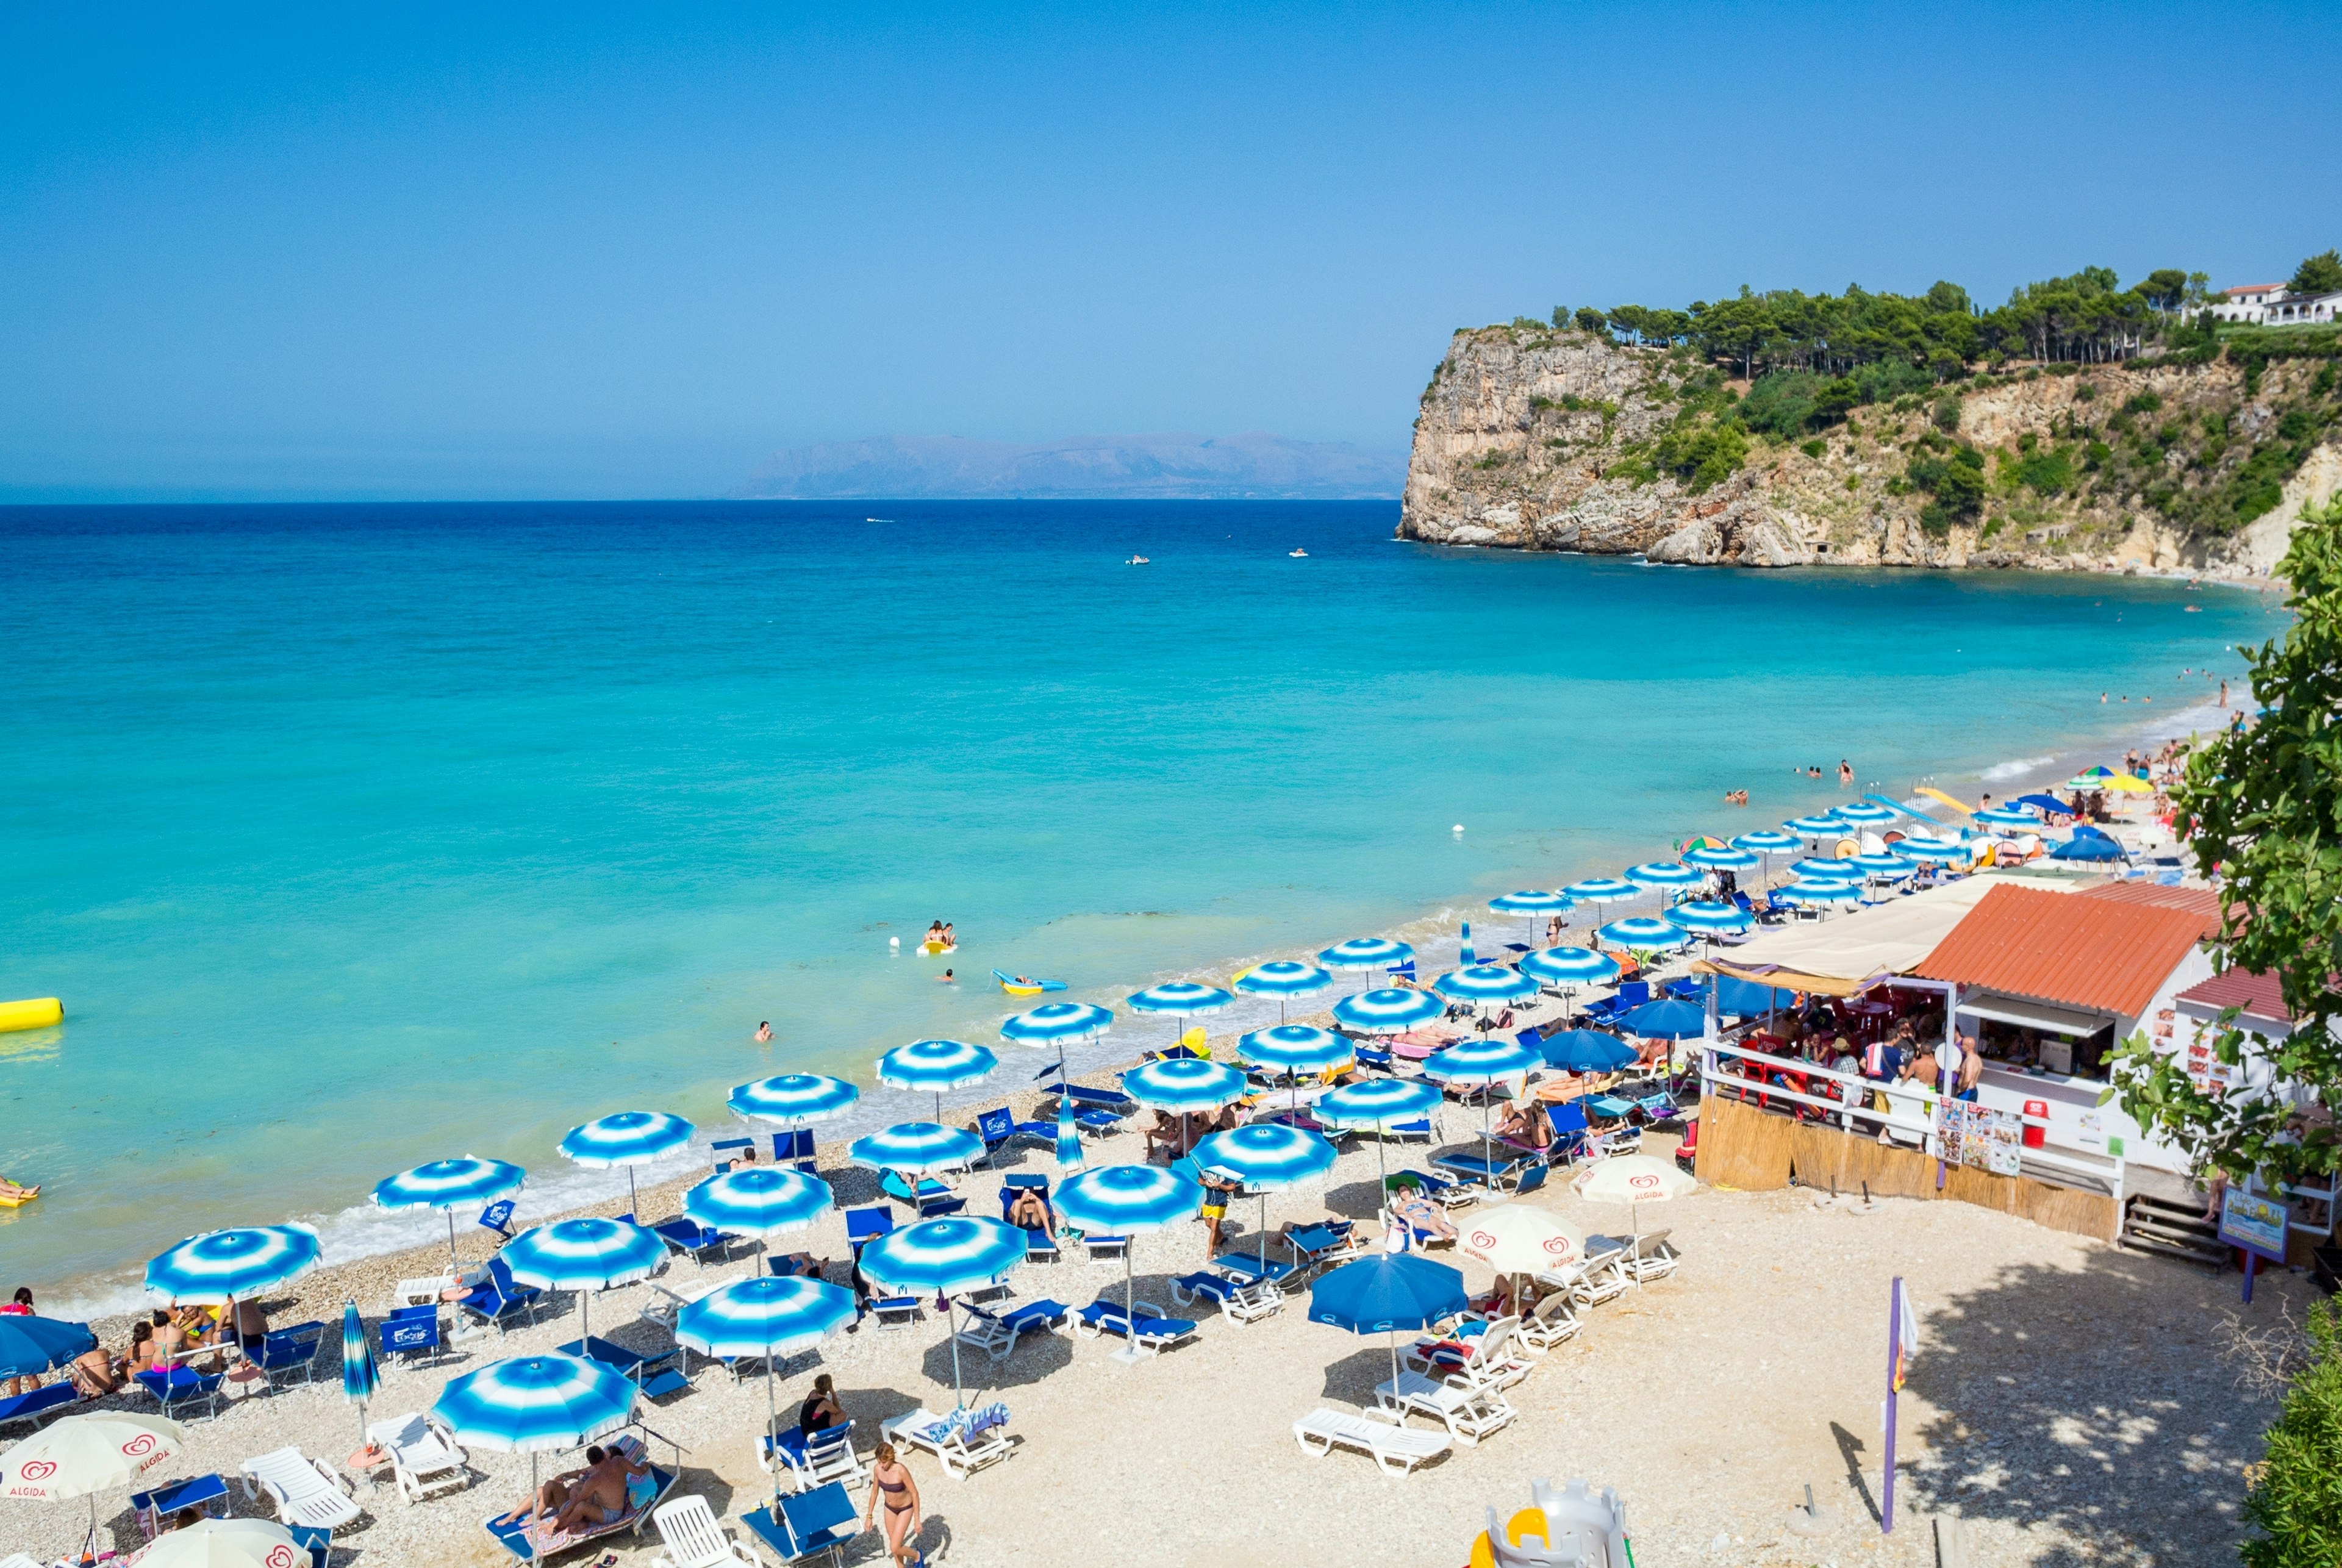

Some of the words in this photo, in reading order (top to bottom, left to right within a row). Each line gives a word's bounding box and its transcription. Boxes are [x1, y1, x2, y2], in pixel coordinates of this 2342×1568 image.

[1635, 1192, 1664, 1200] ALGIDA
[1464, 1247, 1488, 1262] ALGIDA
[1552, 1255, 1575, 1269] ALGIDA
[140, 1450, 170, 1473] ALGIDA
[9, 1487, 46, 1497] ALGIDA
